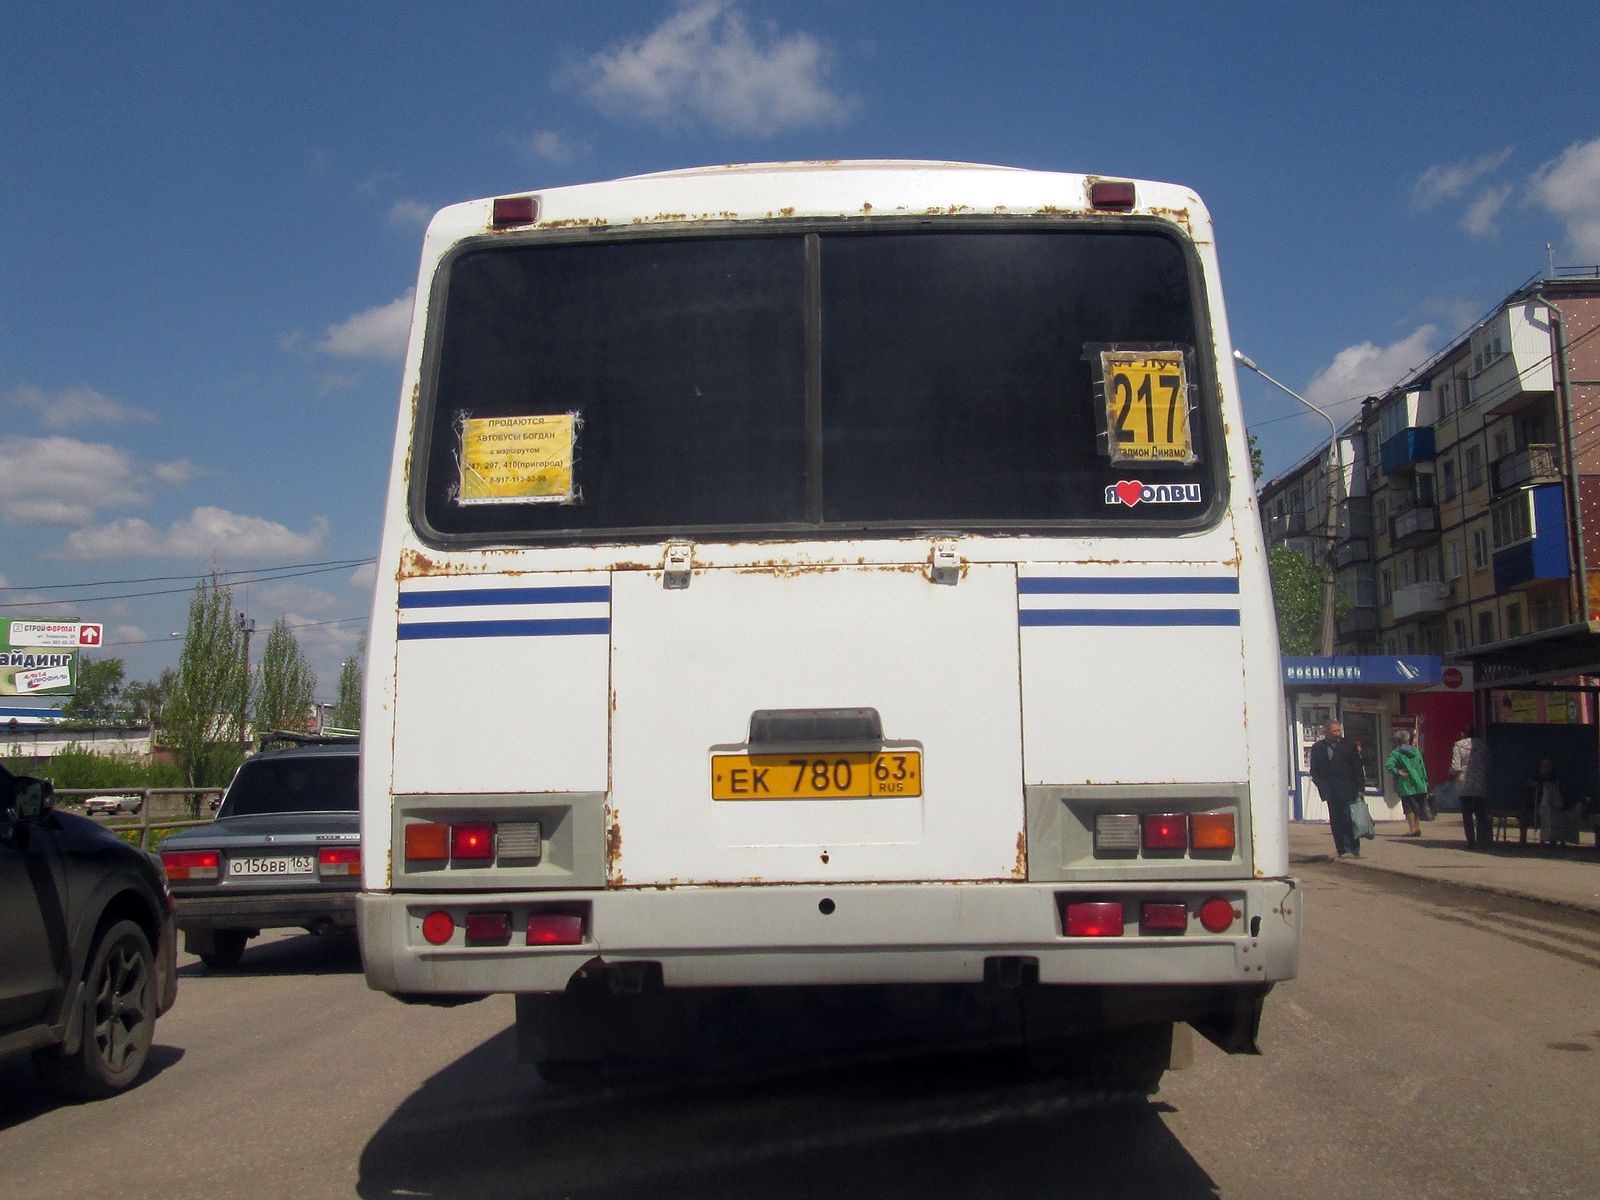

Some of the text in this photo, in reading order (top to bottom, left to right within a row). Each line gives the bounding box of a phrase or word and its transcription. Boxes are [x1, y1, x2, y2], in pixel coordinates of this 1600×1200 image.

[1114, 373, 1181, 444] 217
[488, 417, 545, 427] ПРОДАЮТСЯ
[477, 432, 555, 442] АВТОБУСЫ БОГДАН
[496, 447, 540, 456] маршрутом
[1119, 445, 1186, 458] тадион Динамо
[1105, 485, 1200, 503] Я ОЛВИ
[0, 649, 71, 668] айдинг
[731, 756, 907, 793] ЕК 780 63
[879, 783, 904, 792] RUS
[233, 856, 310, 873] О156ВВ 163
